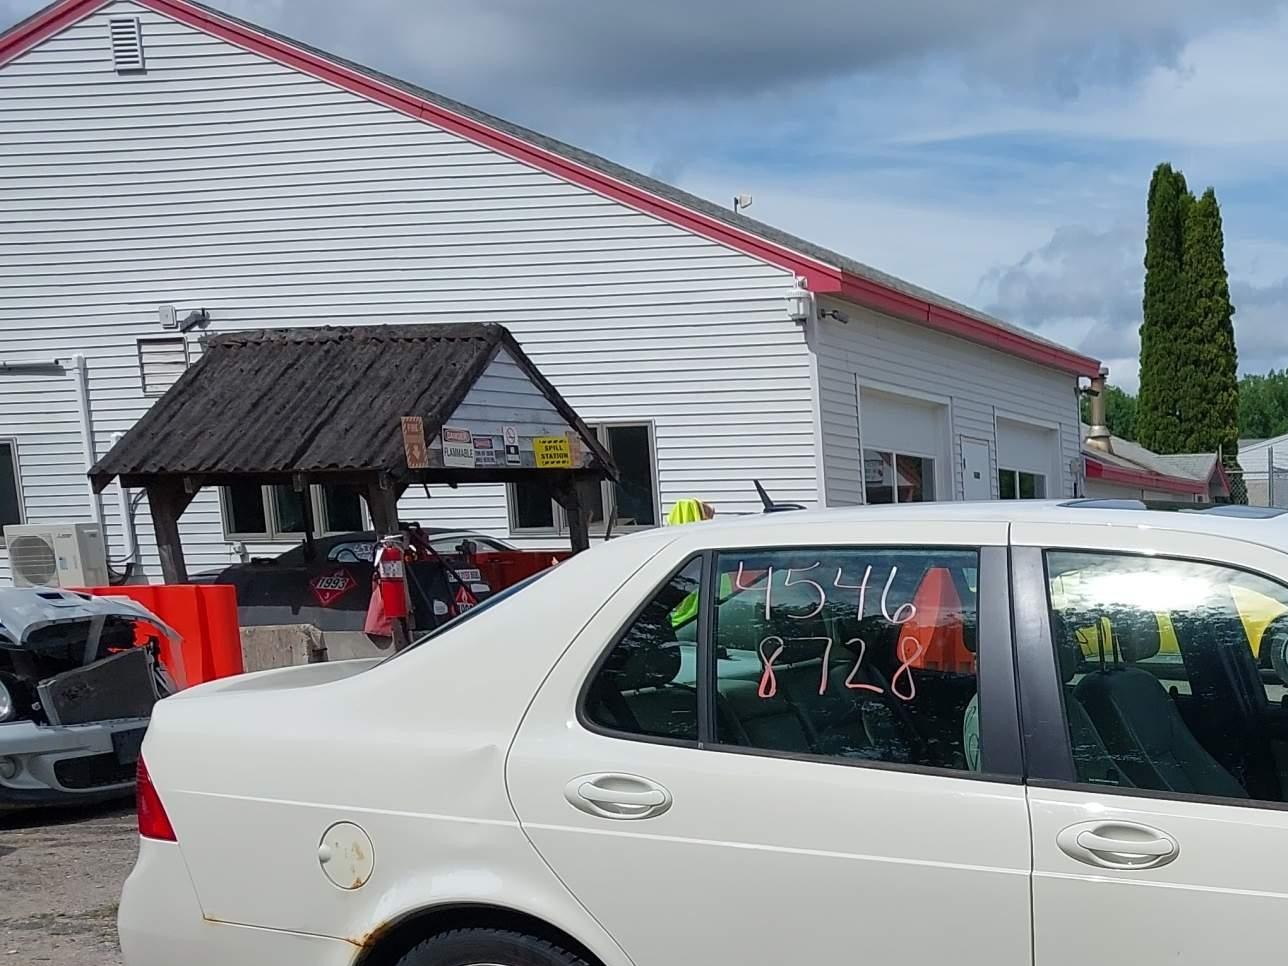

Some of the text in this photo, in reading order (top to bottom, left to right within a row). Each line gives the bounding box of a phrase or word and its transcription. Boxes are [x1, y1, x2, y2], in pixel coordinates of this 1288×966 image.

[444, 447, 473, 458] FLAMMABLE
[319, 577, 346, 589] 1993
[736, 561, 916, 623] 4546
[758, 636, 922, 700] 8728
